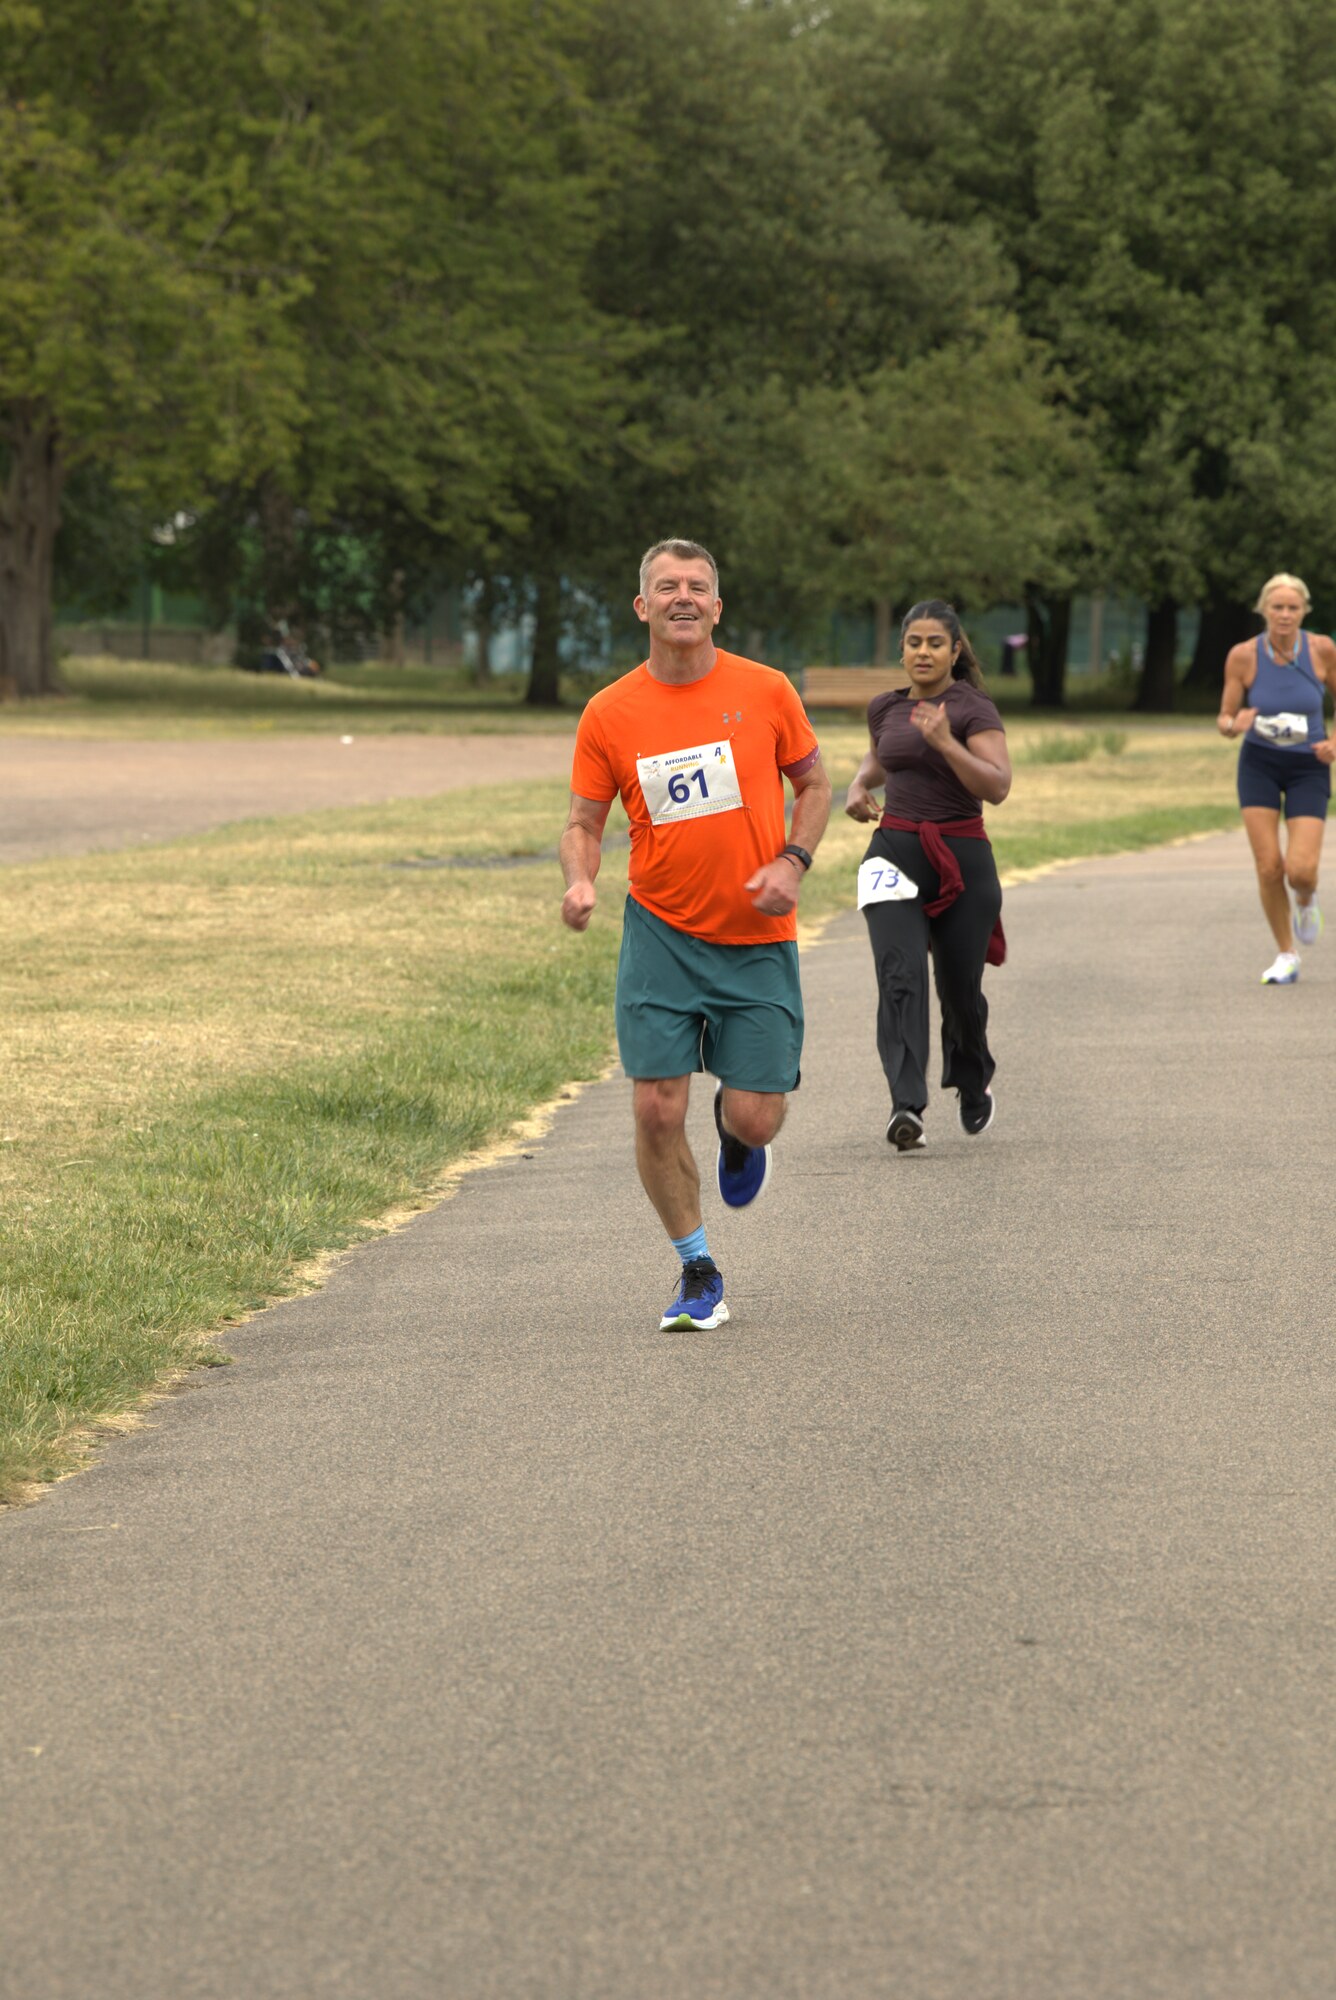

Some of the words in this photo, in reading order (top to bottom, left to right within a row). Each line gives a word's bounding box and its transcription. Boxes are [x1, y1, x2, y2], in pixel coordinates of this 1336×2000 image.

[714, 746, 721, 757] A
[665, 753, 703, 766] AFFORDABLE
[720, 754, 726, 764] R
[670, 761, 699, 772] RUNNING
[668, 769, 709, 803] 61
[871, 869, 898, 890] 73
